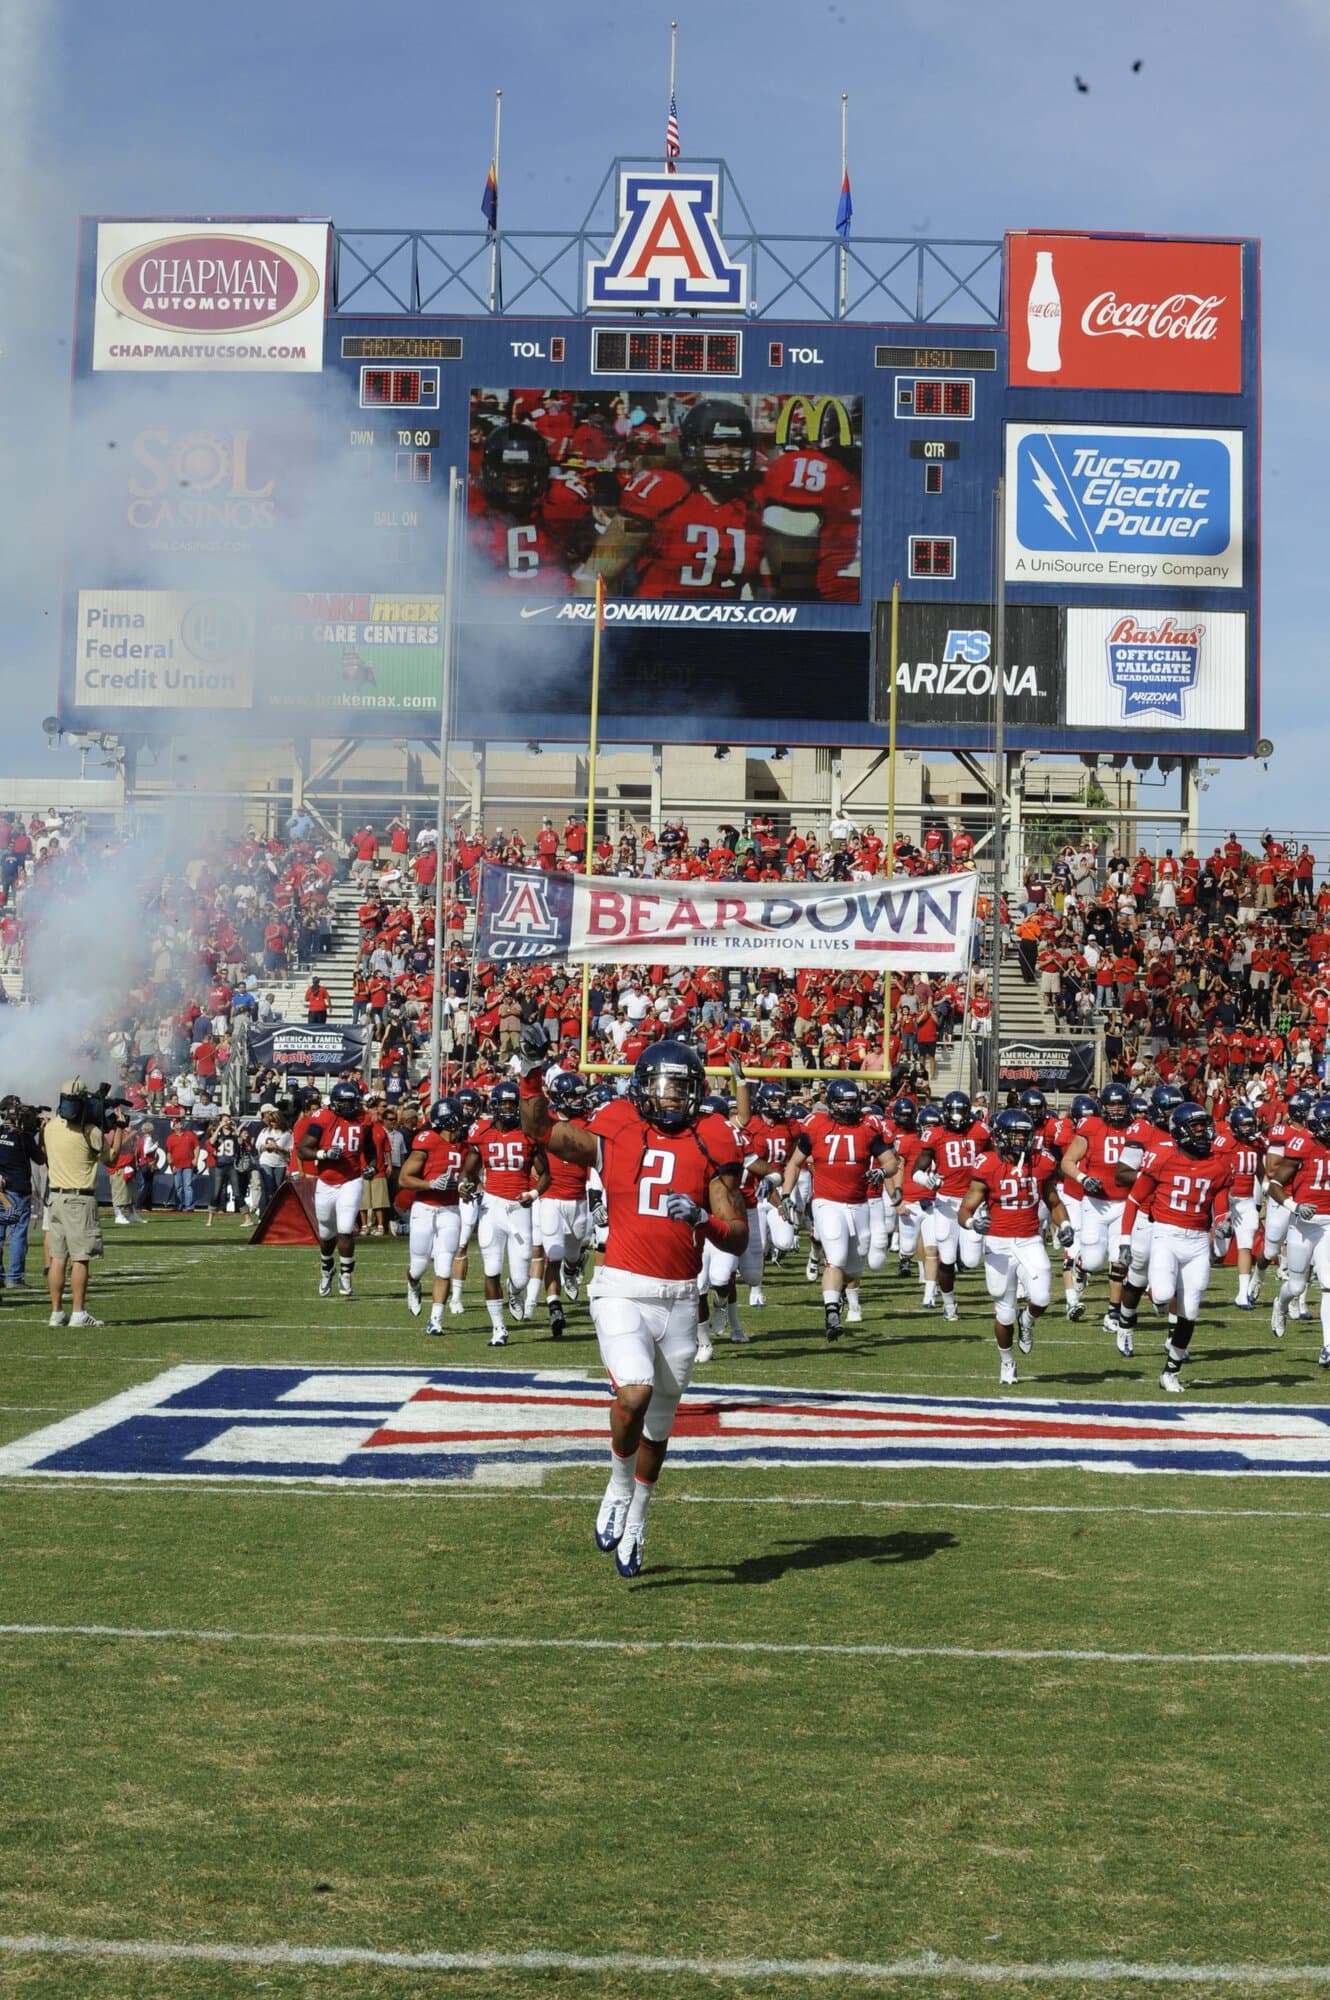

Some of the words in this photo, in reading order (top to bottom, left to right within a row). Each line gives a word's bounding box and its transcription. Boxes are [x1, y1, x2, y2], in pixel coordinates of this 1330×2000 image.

[587, 172, 747, 309] A
[139, 259, 281, 296] CHAPMAN
[142, 297, 277, 311] AUTOMOTIVE
[1081, 291, 1226, 340] Coca-Cola
[109, 345, 307, 360] CHAPMANTUCSON.COM
[510, 342, 546, 358] TOL
[788, 348, 824, 364] TOL
[397, 431, 411, 446] TO
[415, 431, 431, 446] GO
[924, 442, 945, 458] QTR
[1071, 449, 1181, 480] Tucson
[1082, 479, 1209, 509] Electric
[127, 500, 276, 529] CASINOS
[1095, 508, 1209, 538] Power
[1016, 559, 1026, 571] A
[1031, 559, 1104, 573] UniSource
[1108, 561, 1157, 577] Energy
[1162, 562, 1229, 578] Company
[87, 609, 145, 628] Pima
[313, 625, 357, 643] CARE
[363, 626, 439, 644] CENTERS
[943, 630, 991, 663] FS
[85, 639, 173, 659] Federal
[1116, 649, 1192, 661] OFFICIAL
[84, 669, 157, 689] Credit
[164, 669, 236, 689] Union
[887, 662, 1038, 697] ARIZONA
[1116, 662, 1191, 674] TAILGATE
[1116, 674, 1190, 683] HEADQUARTERS
[1129, 692, 1178, 702] ARIZONA
[490, 873, 559, 938] A
[488, 940, 557, 959] CLUB
[693, 936, 721, 947] THE
[724, 936, 804, 949] TRADITION
[811, 938, 850, 950] LIVES
[488, 1142, 524, 1171] 26
[824, 1134, 857, 1165] 71
[945, 1139, 976, 1168] 83
[1104, 1136, 1126, 1164] 6
[637, 1149, 676, 1217] 2
[1000, 1176, 1040, 1210] 23
[1169, 1175, 1211, 1213] 27
